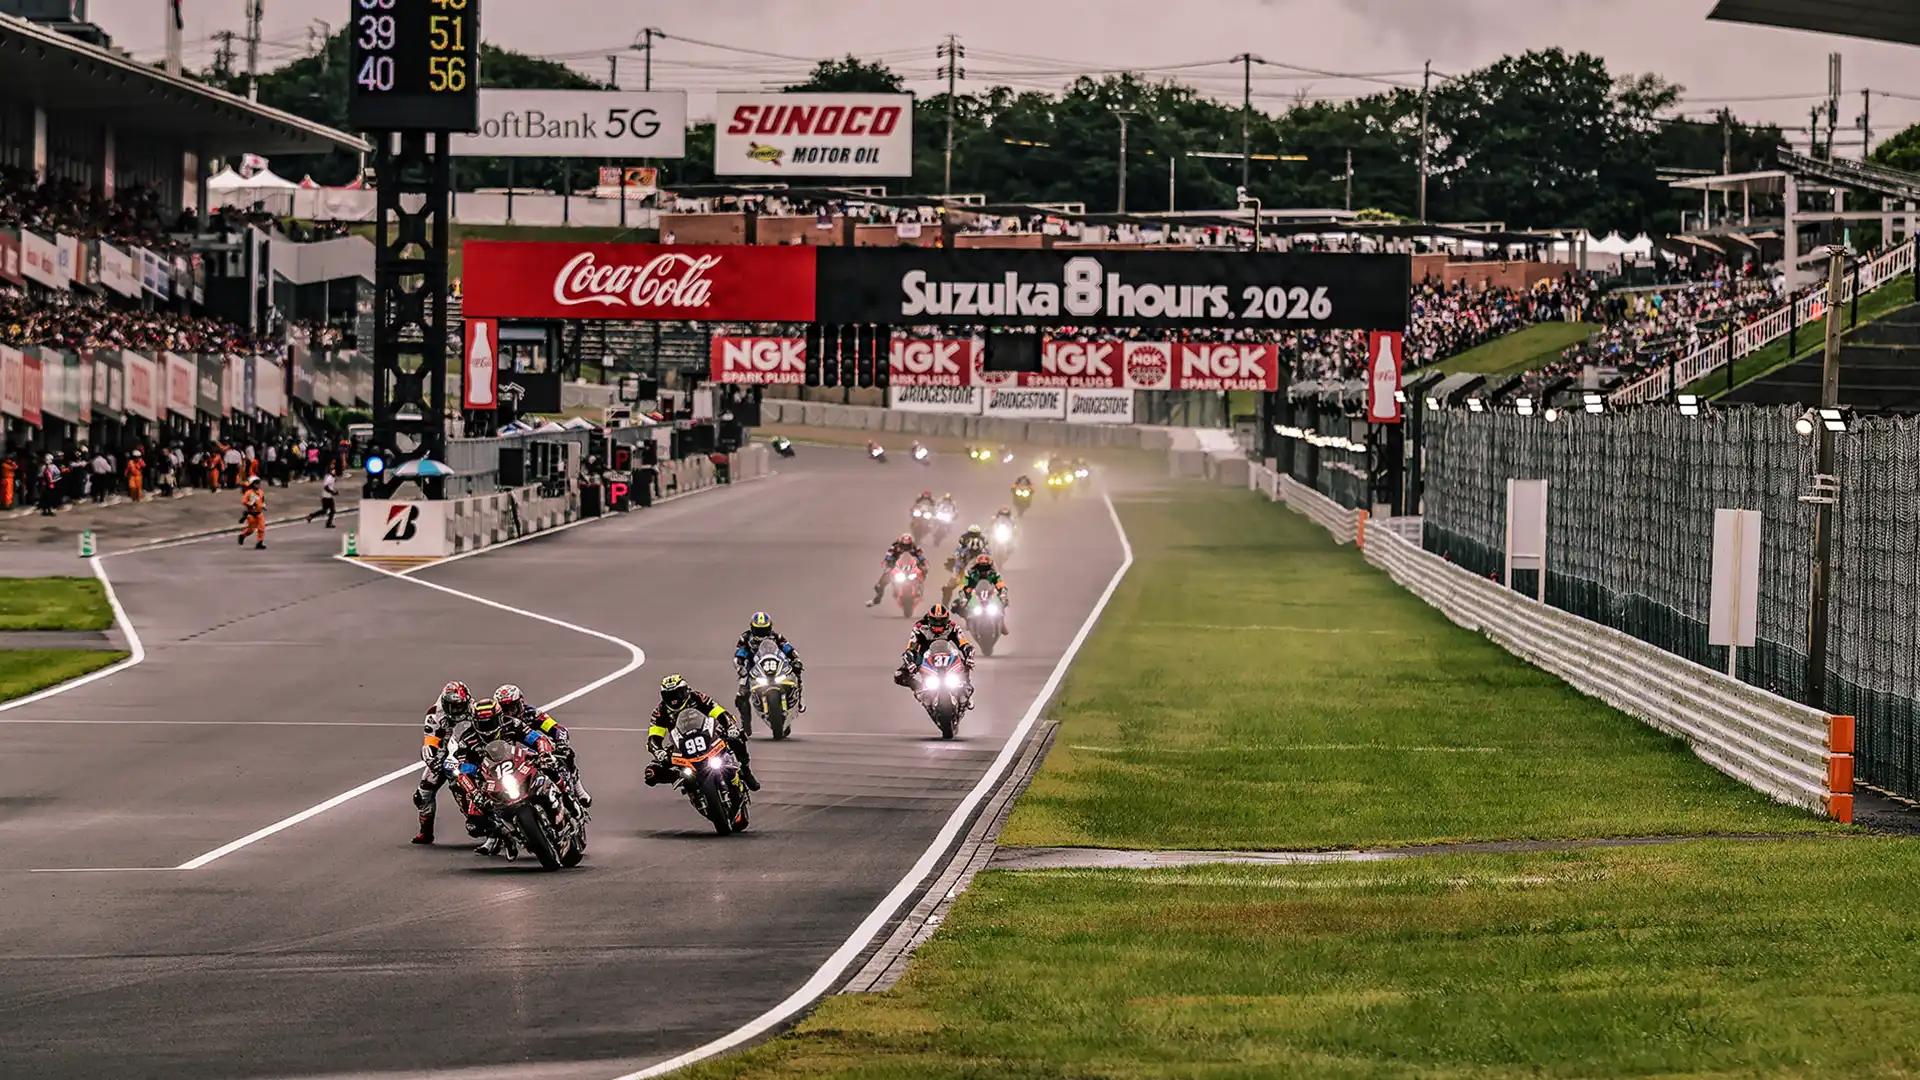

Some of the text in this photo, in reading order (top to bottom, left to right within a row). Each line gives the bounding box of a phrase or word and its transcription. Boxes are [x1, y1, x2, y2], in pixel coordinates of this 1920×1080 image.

[358, 15, 465, 51] 39 51
[358, 56, 466, 91] 40 56
[604, 108, 661, 139] 5G
[727, 105, 902, 136] SUNOCO
[792, 148, 879, 164] MOTOR OIL
[553, 251, 723, 307] Coca-Cola
[902, 269, 1059, 316] Suzuka
[1063, 256, 1103, 317] 8
[1241, 286, 1333, 320] 2026
[723, 340, 806, 371] NGK
[1183, 345, 1267, 378] NGK
[721, 372, 763, 384] SPARK
[918, 375, 961, 387] PLUGS
[1026, 376, 1114, 388] SPARK PLUGS
[1180, 378, 1267, 390] SPARK PLUGS
[898, 386, 975, 405] BRIDGESTONE
[989, 389, 1060, 410] BRIDGESTONE
[1071, 393, 1130, 415] BRIDGESTONE
[611, 483, 628, 504] P
[934, 655, 950, 667] 37
[684, 735, 707, 755] 99
[495, 760, 514, 780] 12
